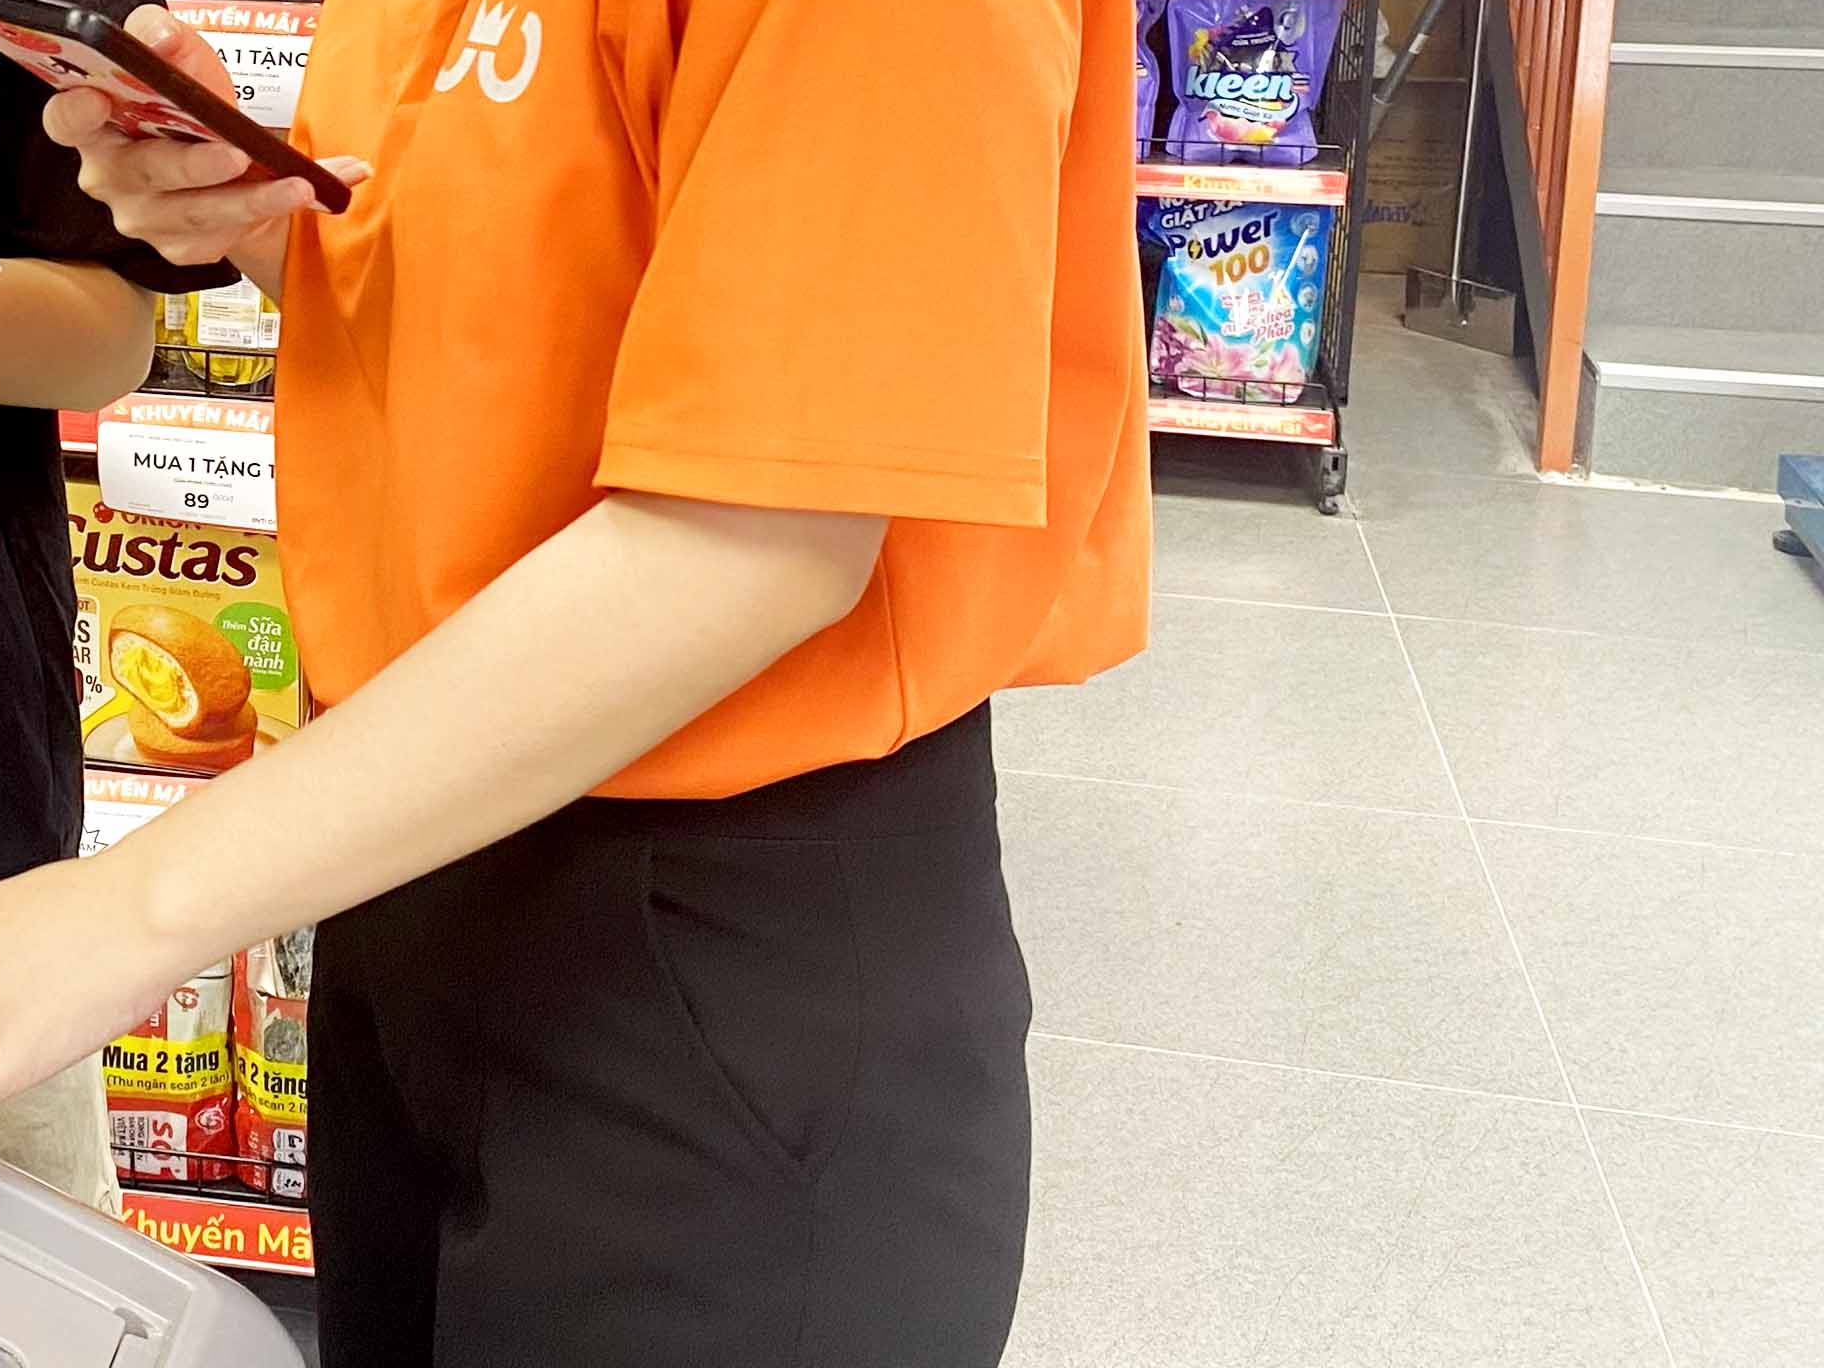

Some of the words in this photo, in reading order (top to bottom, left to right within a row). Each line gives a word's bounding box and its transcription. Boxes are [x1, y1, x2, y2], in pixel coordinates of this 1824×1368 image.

[1183, 62, 1295, 103] kleen
[1159, 203, 1211, 231] GIẶT
[1208, 243, 1271, 287] 100
[130, 402, 222, 425] KHUYẾN
[133, 452, 183, 473] MUA
[188, 457, 197, 473] 1
[202, 455, 262, 480] TẶNG
[183, 492, 210, 509] 89
[222, 619, 247, 632] Thêm
[248, 616, 282, 637] Sữa
[247, 633, 282, 654] đậu
[244, 652, 285, 671] nành
[102, 1044, 149, 1073] Mua
[155, 1050, 169, 1074] 2
[176, 1049, 220, 1079] tặng
[106, 1073, 135, 1089] (Thu
[136, 1077, 167, 1092] ngân
[170, 1079, 198, 1092] scan
[200, 1077, 208, 1089] 2
[249, 1063, 260, 1086] 2
[263, 1070, 308, 1100] tặng
[257, 1096, 286, 1112] scan
